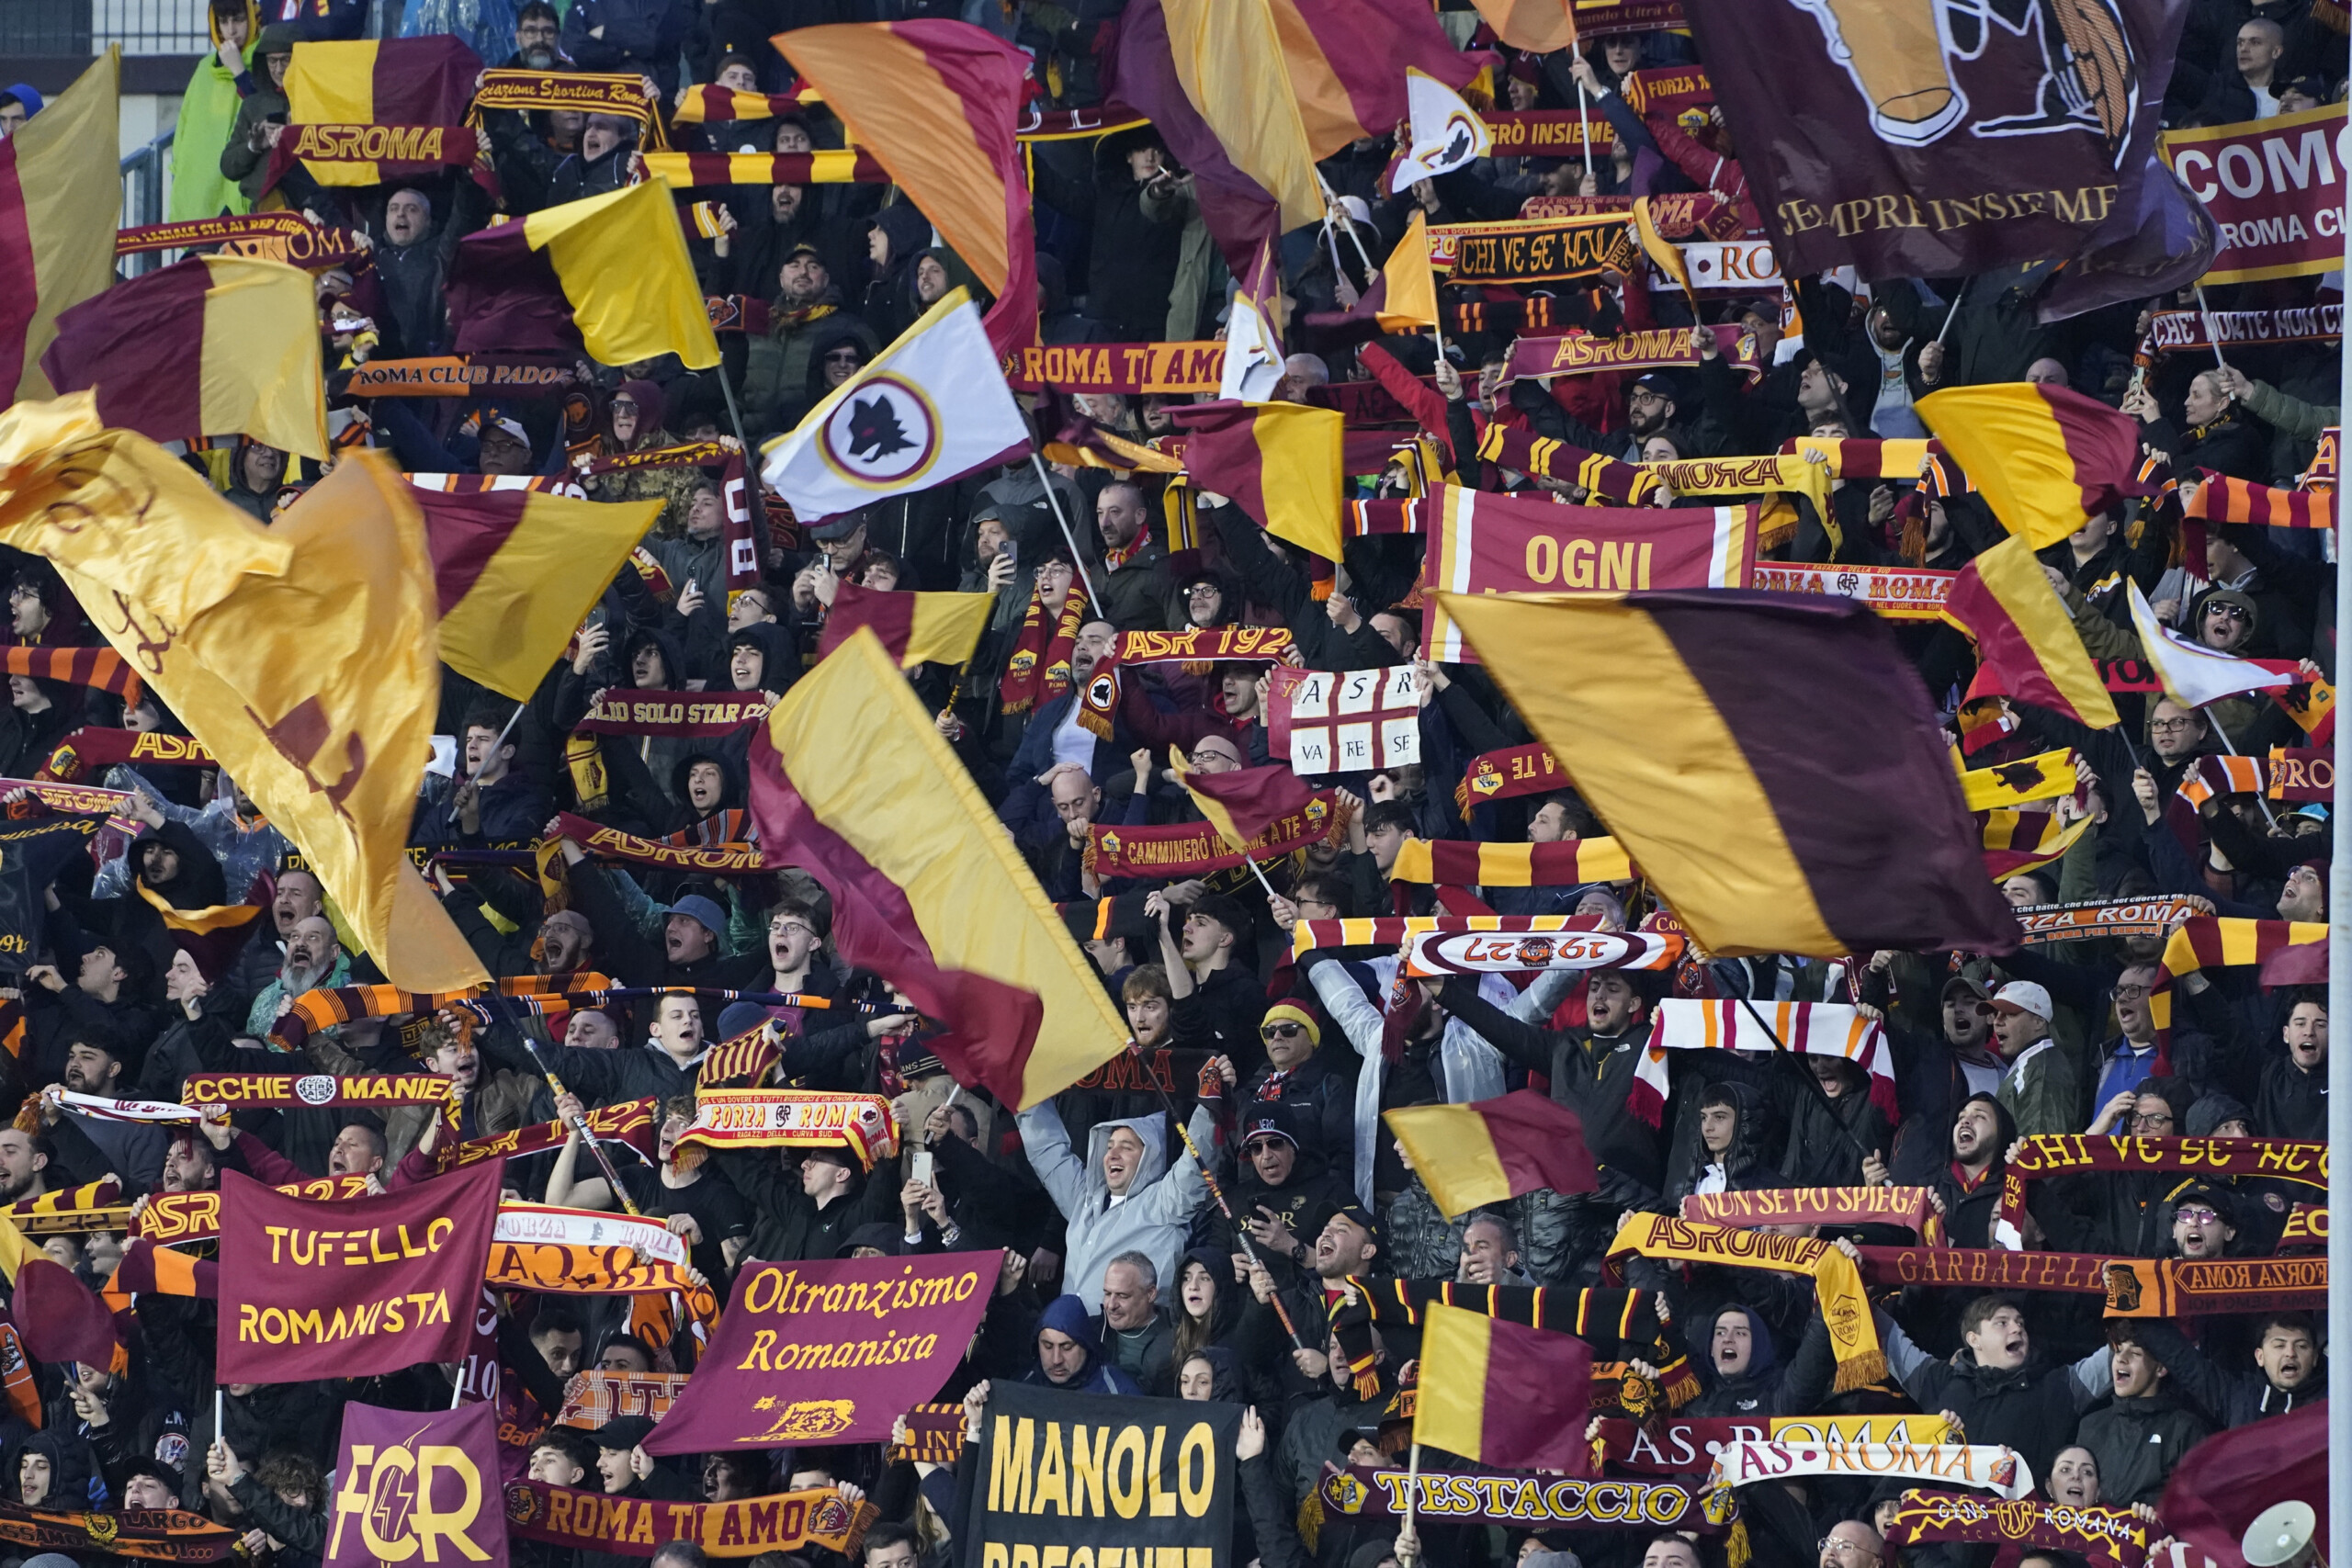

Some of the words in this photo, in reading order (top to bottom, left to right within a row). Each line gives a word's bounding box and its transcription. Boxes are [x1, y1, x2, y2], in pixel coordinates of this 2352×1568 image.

[540, 79, 604, 99] Sportiva
[608, 84, 649, 106] Roma
[1648, 76, 1695, 99] FORZA
[293, 124, 444, 161] ASROMA
[1556, 197, 1582, 205] ROMA
[1585, 197, 1604, 205] NON
[2220, 214, 2309, 251] ROMA
[1462, 238, 1498, 275] CHI
[1502, 237, 1526, 273] VE
[1530, 233, 1556, 272] SE
[2274, 307, 2317, 338] NON
[1553, 328, 1692, 367] ASROMA
[359, 367, 423, 386] ROMA
[428, 366, 488, 384] CLUB
[1023, 346, 1114, 384] ROMA
[1123, 348, 1158, 384] TI
[1525, 535, 1652, 591] OGNI
[1813, 564, 1842, 572] RAGAZZI
[1877, 567, 1891, 575] SUD
[1869, 575, 1955, 602] ROMA
[1876, 601, 1889, 609] NEL
[1892, 602, 1914, 610] CUORE
[634, 703, 684, 724] SOLO
[688, 703, 741, 724] STAR
[1302, 744, 1323, 761] VA
[1347, 739, 1364, 757] RE
[1270, 822, 1282, 843] A
[1283, 815, 1300, 839] TE
[2097, 904, 2192, 922] ROMA
[728, 1095, 752, 1103] DOVERE
[831, 1094, 854, 1102] ONORE
[855, 1094, 863, 1102] DI
[708, 1105, 766, 1129] FORZA
[798, 1104, 861, 1129] ROMA
[737, 1130, 763, 1138] RAGAZZI
[766, 1130, 786, 1138] DELLA
[792, 1130, 815, 1138] CURVA
[818, 1130, 832, 1138] SUD
[2017, 1134, 2095, 1171] CHI
[1758, 1187, 1789, 1214] SE
[1795, 1187, 1830, 1213] PO
[1836, 1187, 1920, 1216] SPIEGA
[265, 1217, 455, 1267] TUFELLO
[1645, 1215, 1830, 1267] ASROMA
[744, 1265, 978, 1319] Oltranzismo
[239, 1288, 452, 1345] ROMANISTA
[1837, 1323, 1860, 1337] ROMA
[737, 1329, 938, 1371] Romanista
[1624, 1425, 1695, 1465] AS
[988, 1415, 1216, 1519] MANOLO
[1740, 1441, 1794, 1480] AS
[1824, 1441, 1984, 1482] ROMA
[1375, 1471, 1690, 1527] TESTACCIO
[121, 1509, 208, 1530] LARGO
[546, 1489, 654, 1545] ROMA
[668, 1504, 705, 1547] TI
[718, 1499, 806, 1547] AMO
[2044, 1508, 2131, 1540] ROMANA
